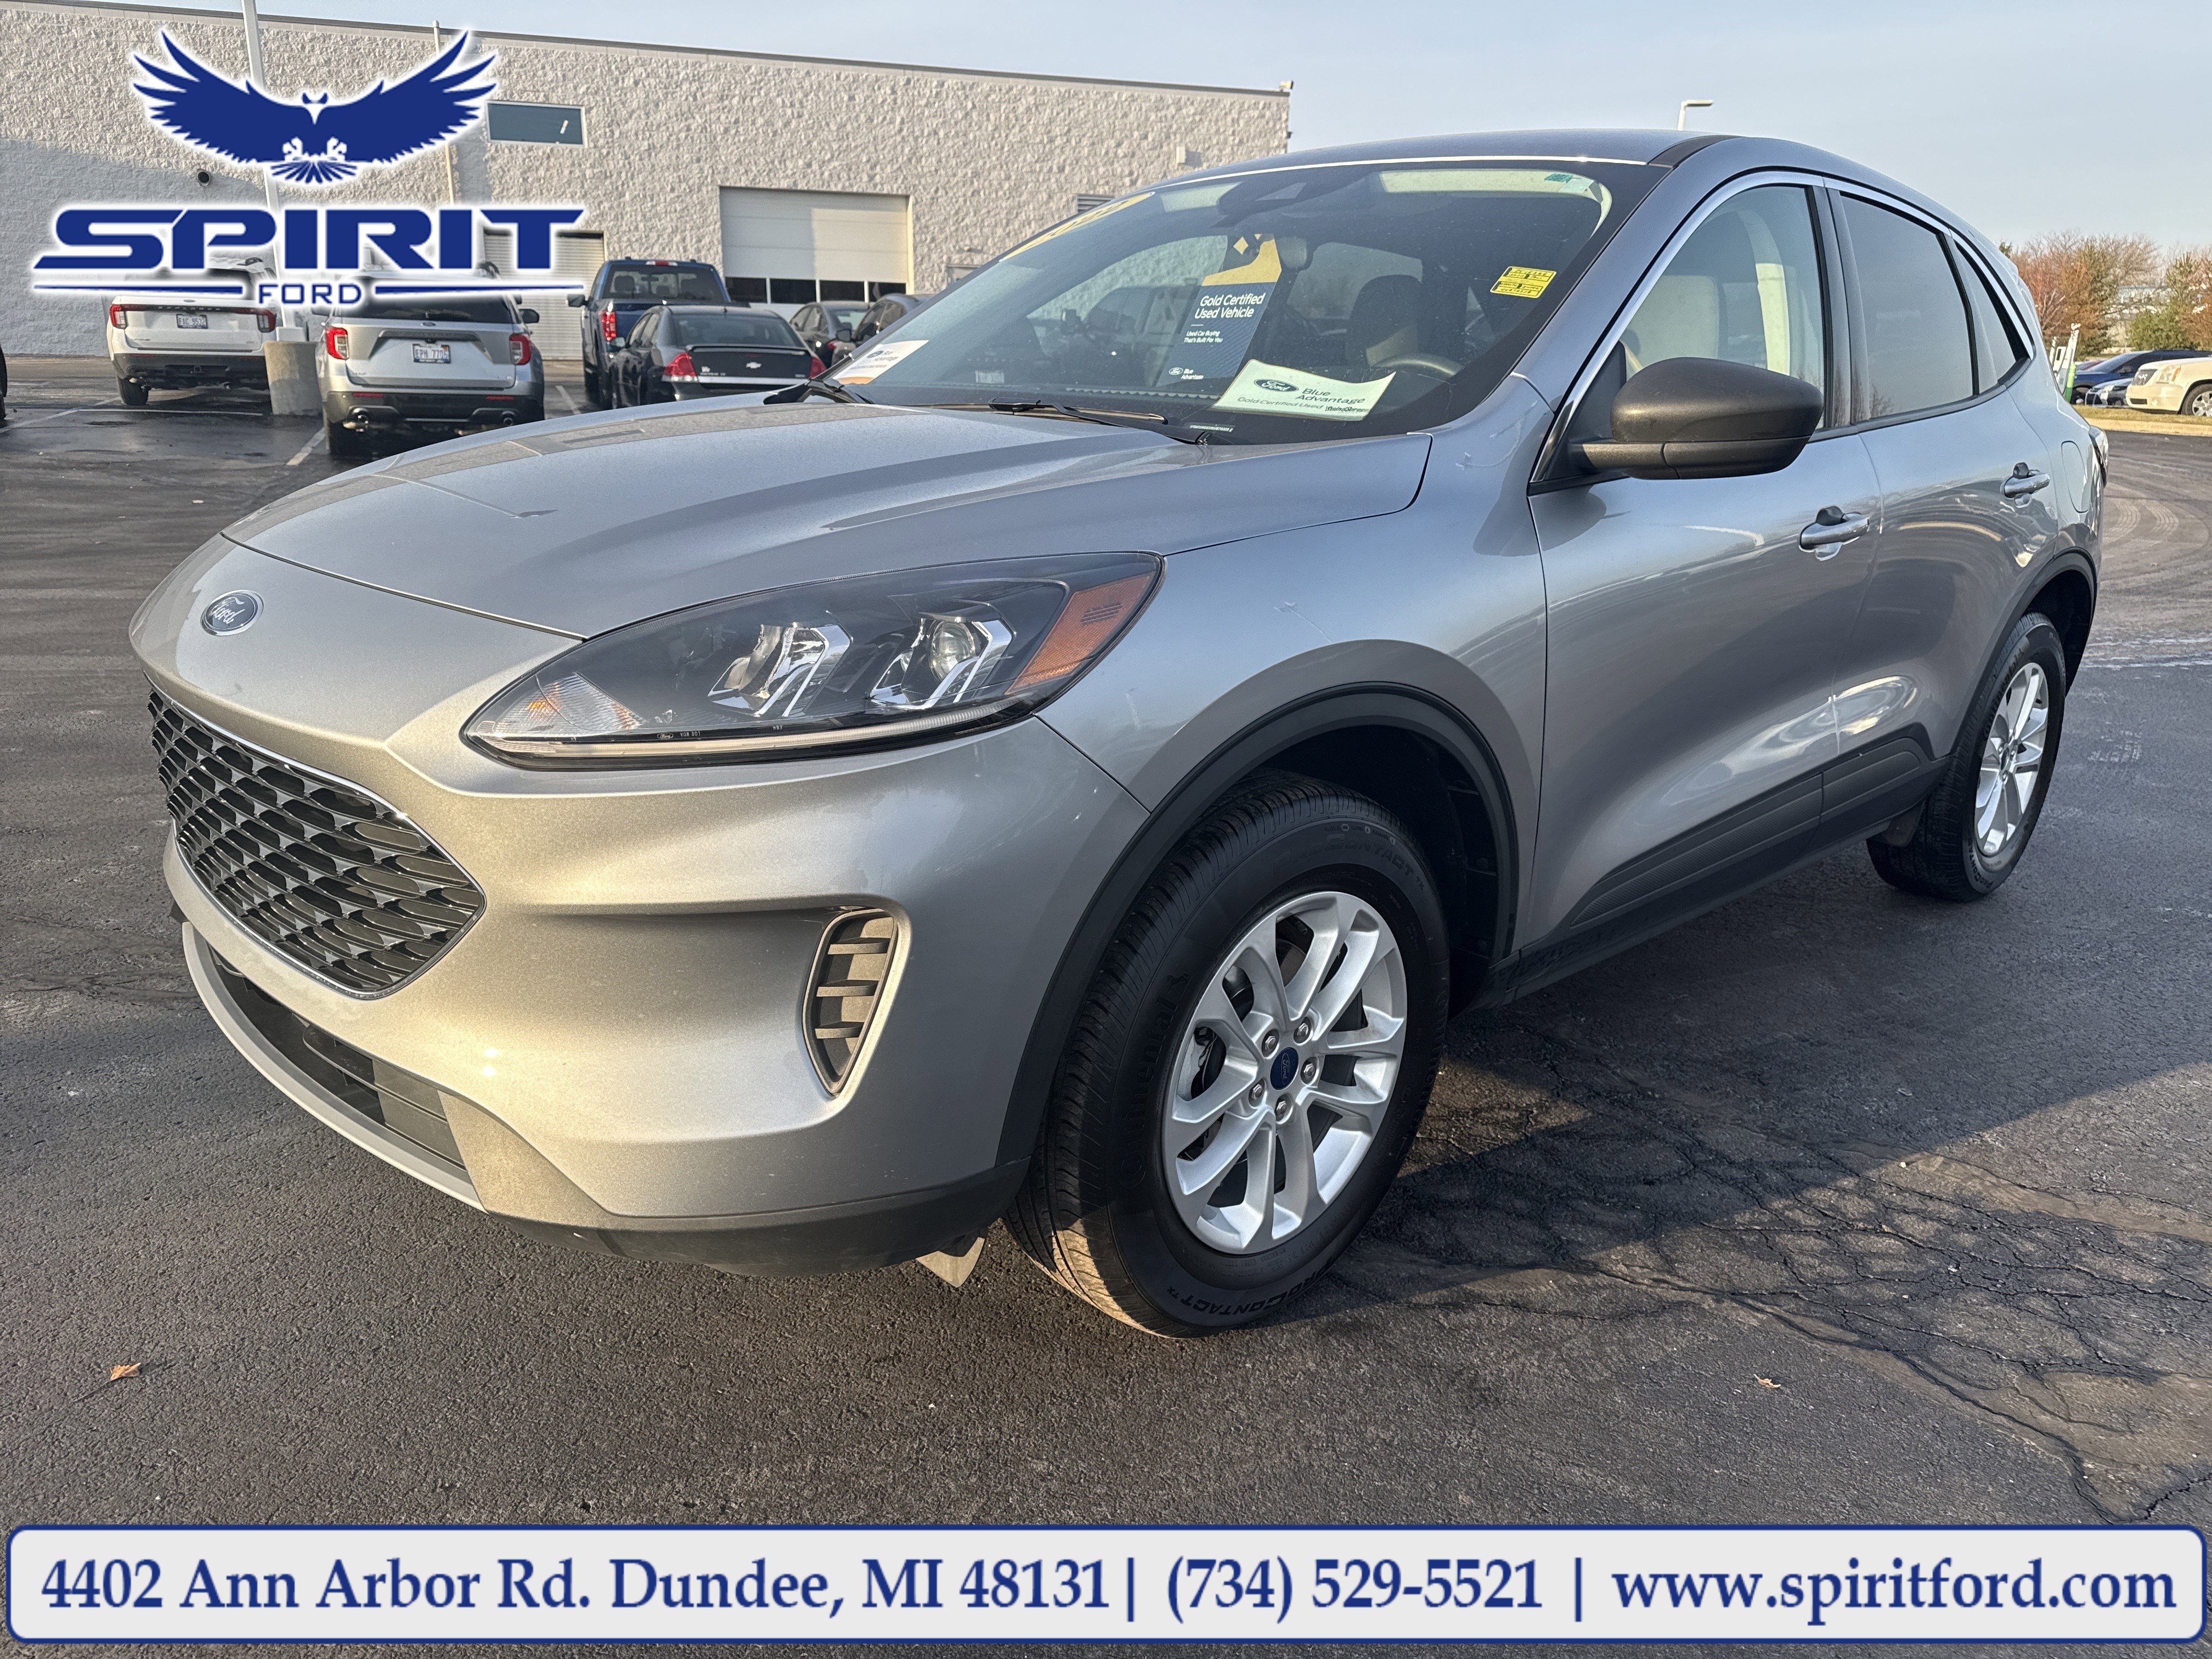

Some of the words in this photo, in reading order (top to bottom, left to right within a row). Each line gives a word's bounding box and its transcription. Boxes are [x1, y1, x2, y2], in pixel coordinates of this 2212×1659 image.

[1200, 294, 1224, 307] Gold
[1223, 292, 1266, 306] Certified
[1194, 307, 1220, 319] Used
[1221, 306, 1255, 318] Vehicle
[1261, 381, 1291, 391] Ford
[1295, 394, 1365, 404] Advantage
